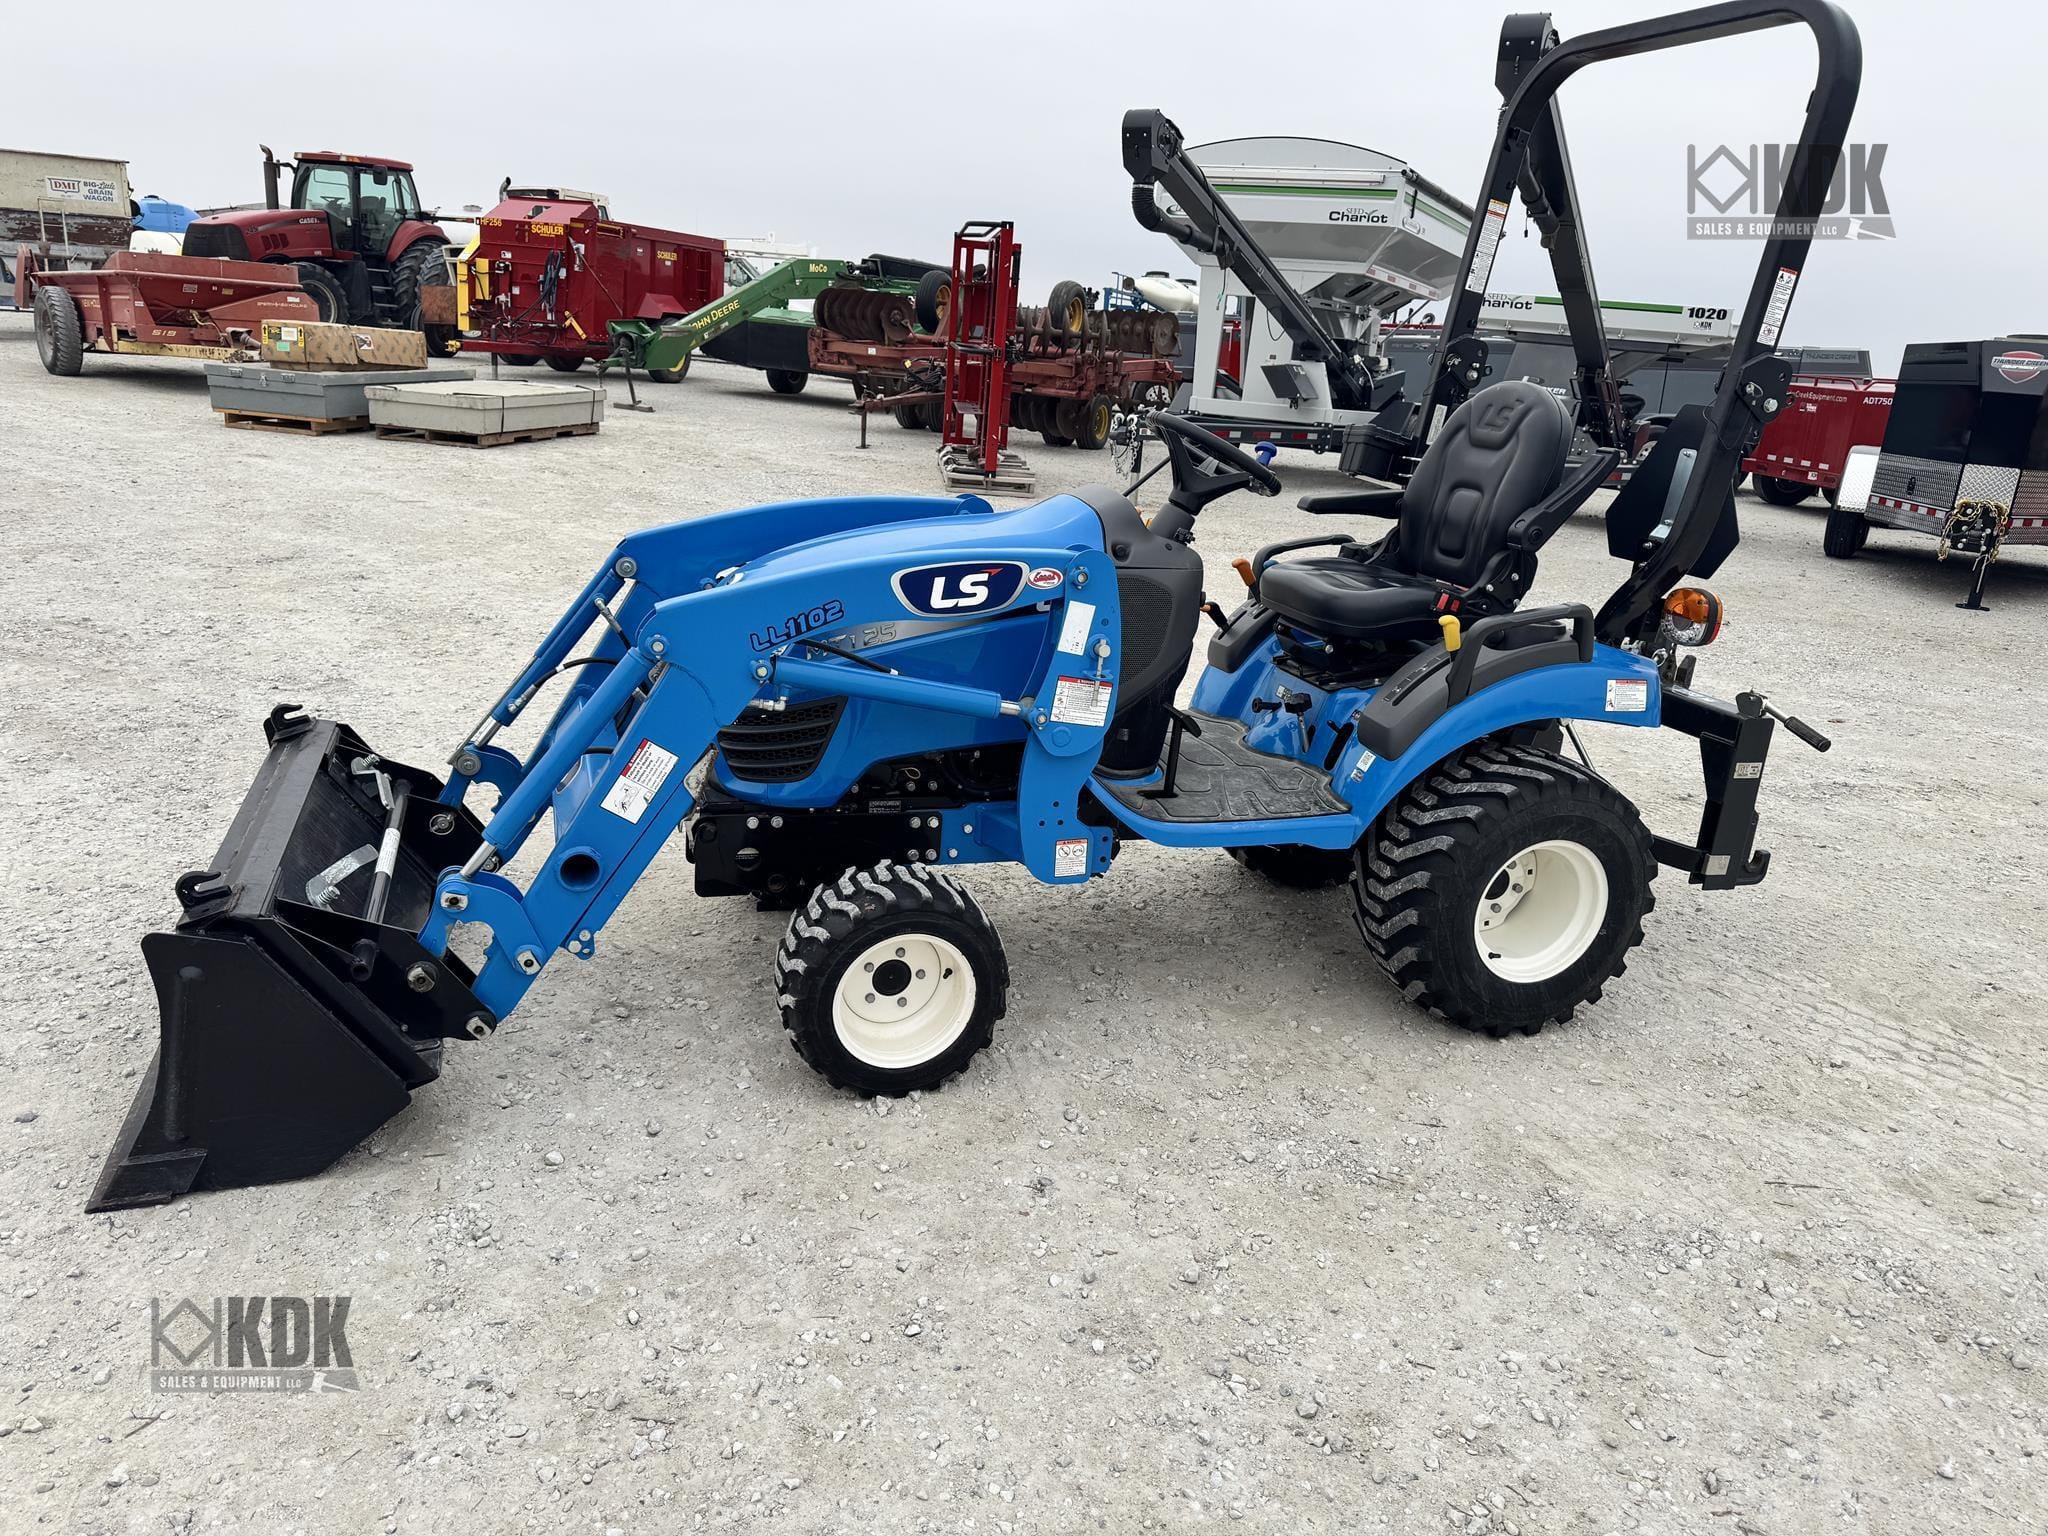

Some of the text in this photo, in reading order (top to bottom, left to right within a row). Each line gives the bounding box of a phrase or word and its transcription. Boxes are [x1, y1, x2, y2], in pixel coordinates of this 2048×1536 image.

[54, 181, 76, 190] DMI
[88, 188, 113, 196] GRAIN
[83, 194, 114, 202] WAGON
[1329, 211, 1388, 223] Chariot
[480, 219, 502, 227] HF256
[531, 224, 564, 235] SCHULER
[657, 250, 677, 261] SCHULER
[809, 263, 828, 273] MoCo
[1481, 297, 1533, 310] hariot
[711, 299, 741, 322] DEERE
[1687, 307, 1728, 320] 1020
[1862, 397, 1894, 405] ADT750
[929, 572, 990, 610] LS
[750, 600, 844, 651] LL1102
